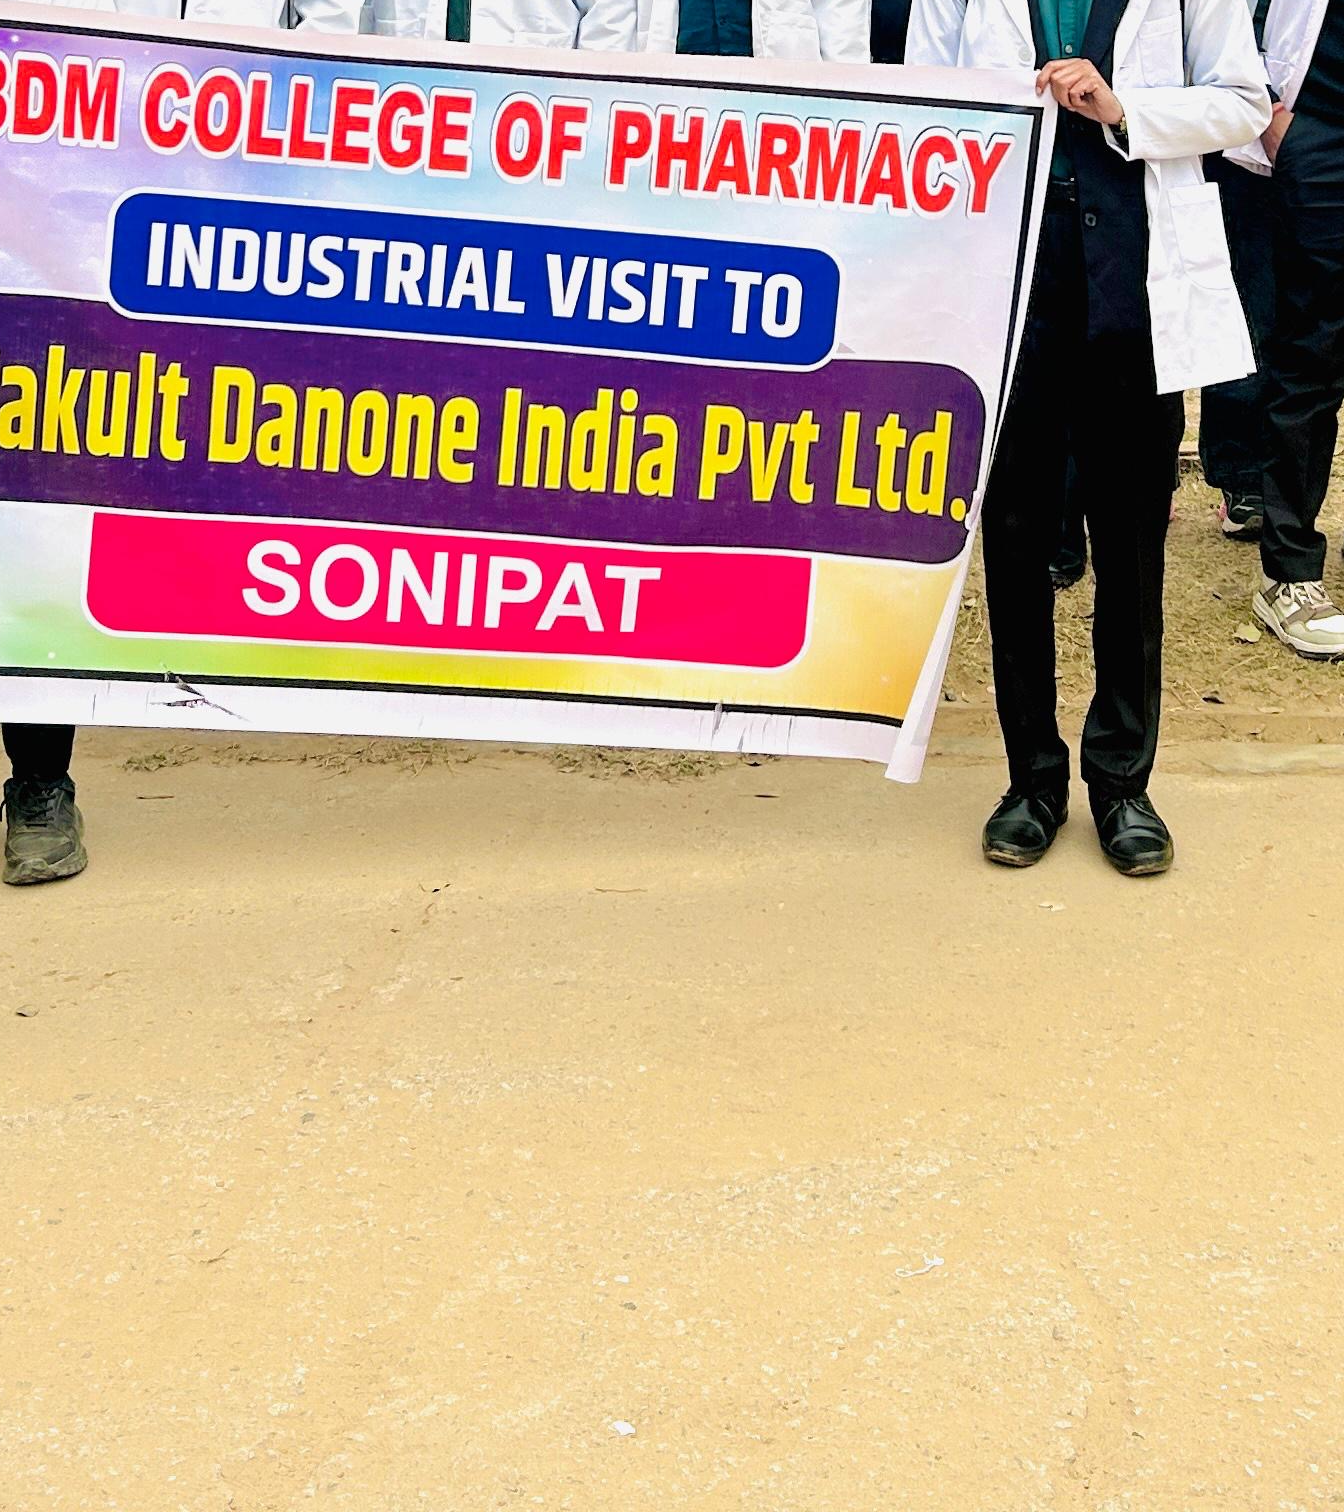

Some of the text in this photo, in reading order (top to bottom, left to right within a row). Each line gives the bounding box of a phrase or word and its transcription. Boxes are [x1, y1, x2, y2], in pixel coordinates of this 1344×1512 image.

[145, 72, 471, 171] COLLEGE
[496, 101, 586, 178] OF
[610, 111, 1008, 212] PHARMACY
[147, 223, 802, 337] INDUSTRIAL VISIT TO
[208, 367, 477, 482] Danone
[499, 388, 676, 495] India
[699, 406, 817, 503] Pvt
[837, 412, 966, 520] Ltd.
[243, 541, 663, 631] SONIPAT
